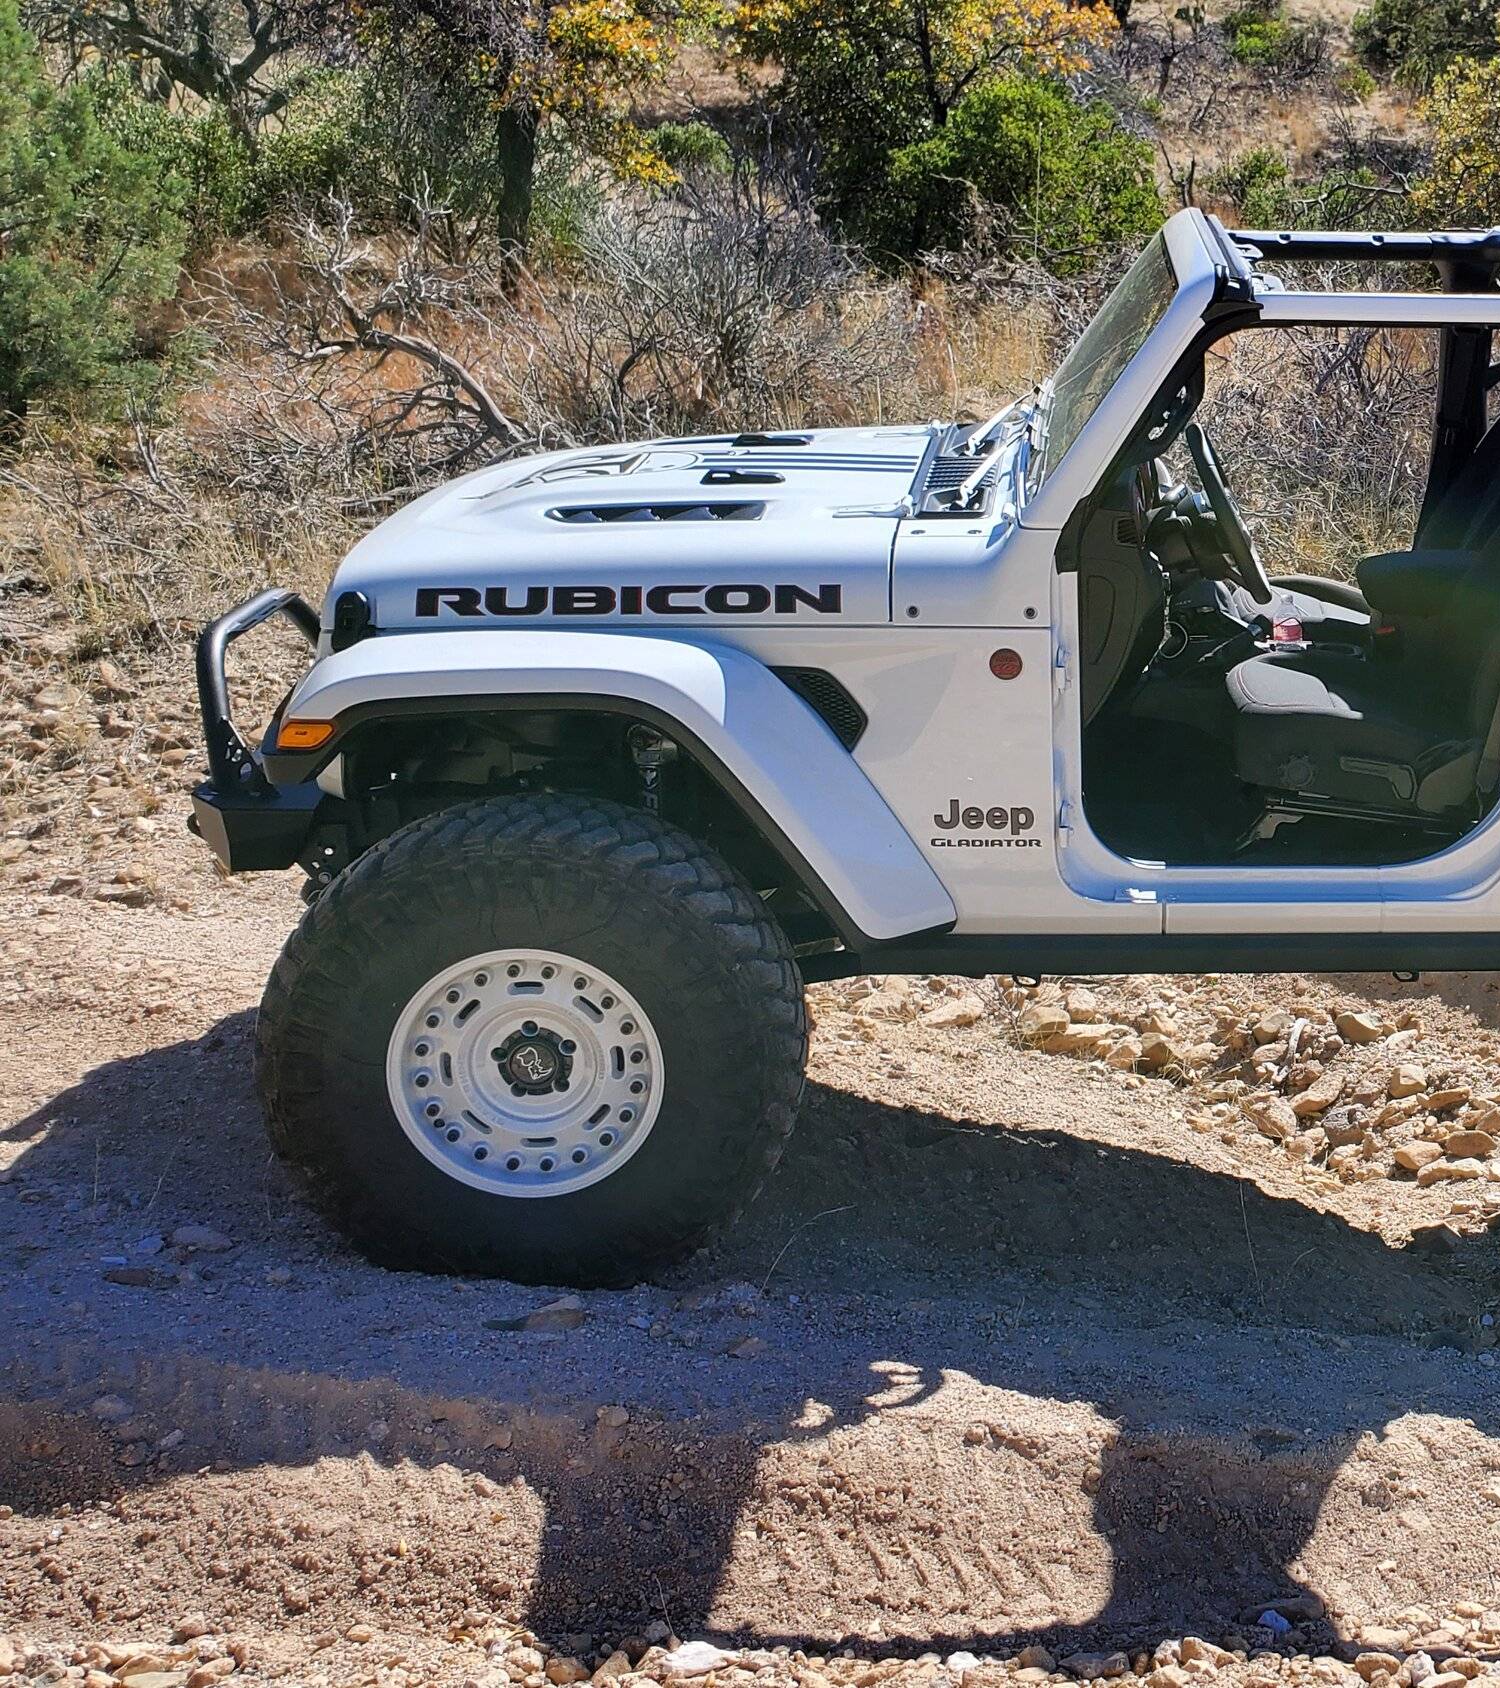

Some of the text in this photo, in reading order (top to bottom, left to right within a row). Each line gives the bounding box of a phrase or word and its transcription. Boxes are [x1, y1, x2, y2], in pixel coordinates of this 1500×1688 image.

[415, 584, 843, 617] RUBICON
[933, 798, 1035, 836] Jeep
[930, 838, 1043, 848] GLADIATOR
